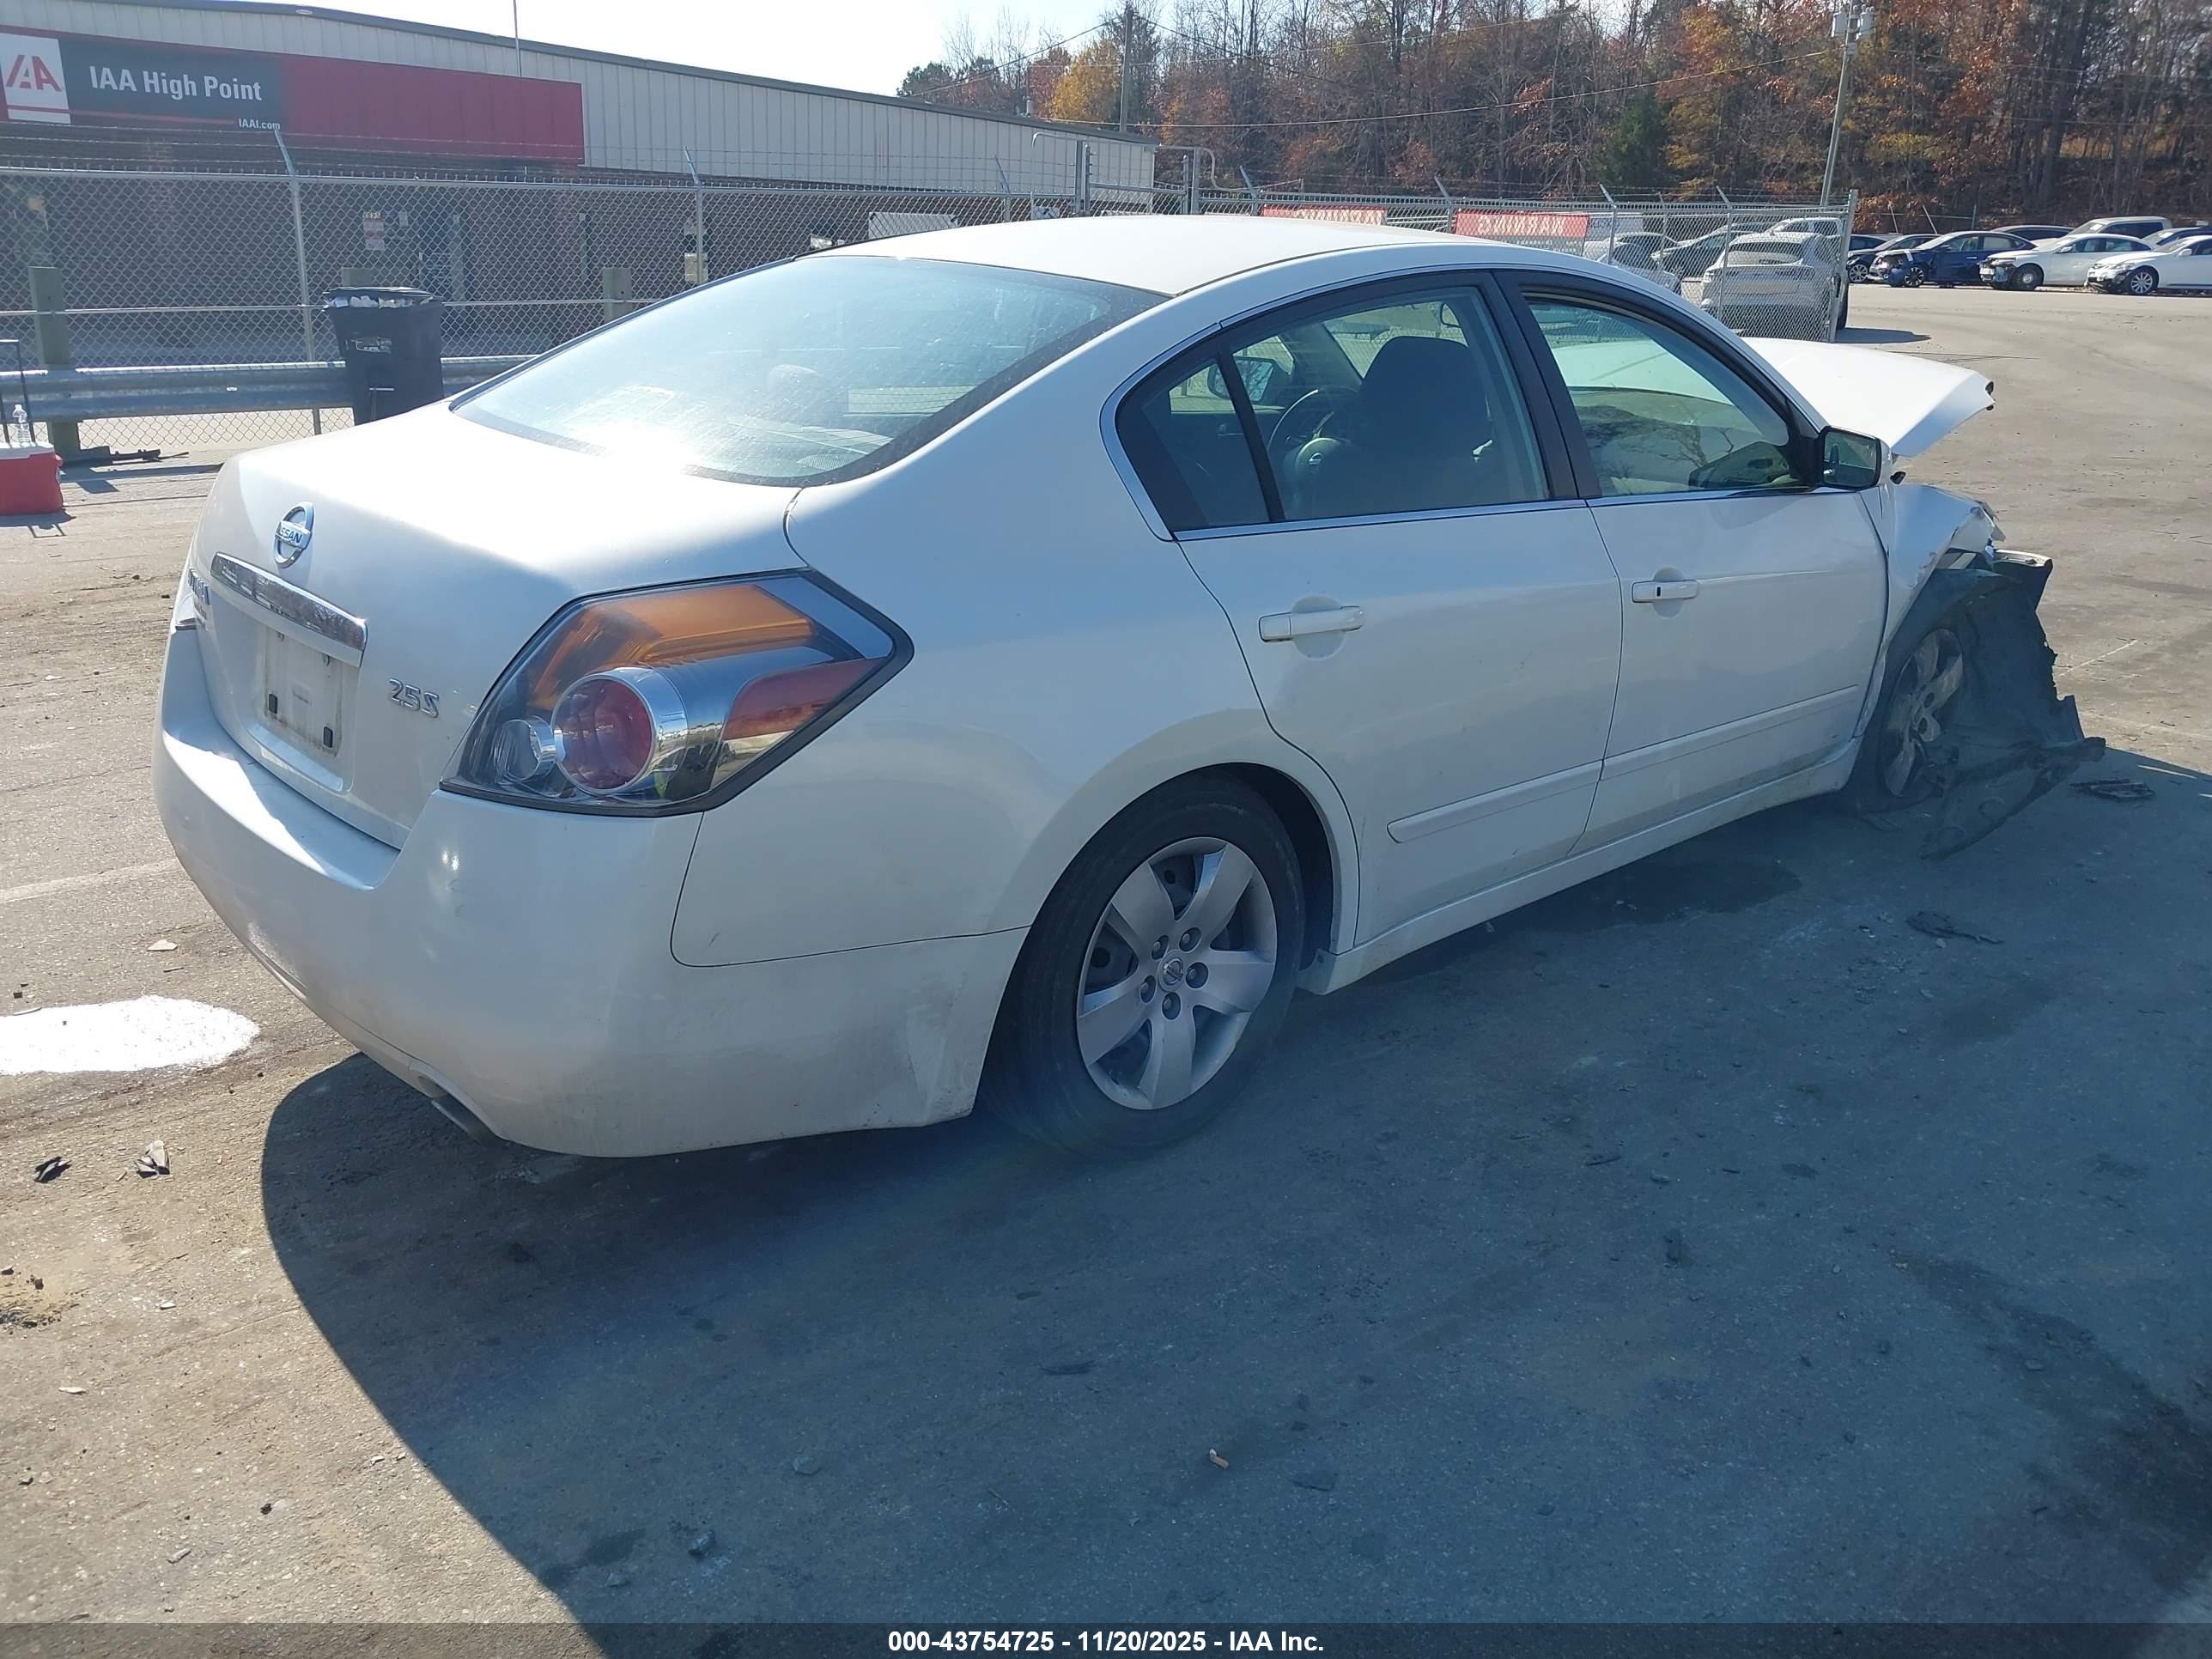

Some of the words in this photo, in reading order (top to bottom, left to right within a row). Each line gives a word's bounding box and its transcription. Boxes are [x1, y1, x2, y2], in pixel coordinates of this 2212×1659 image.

[89, 65, 137, 92] IAA
[143, 70, 198, 100] High
[204, 76, 262, 100] Point
[238, 118, 281, 130] IAAI.com
